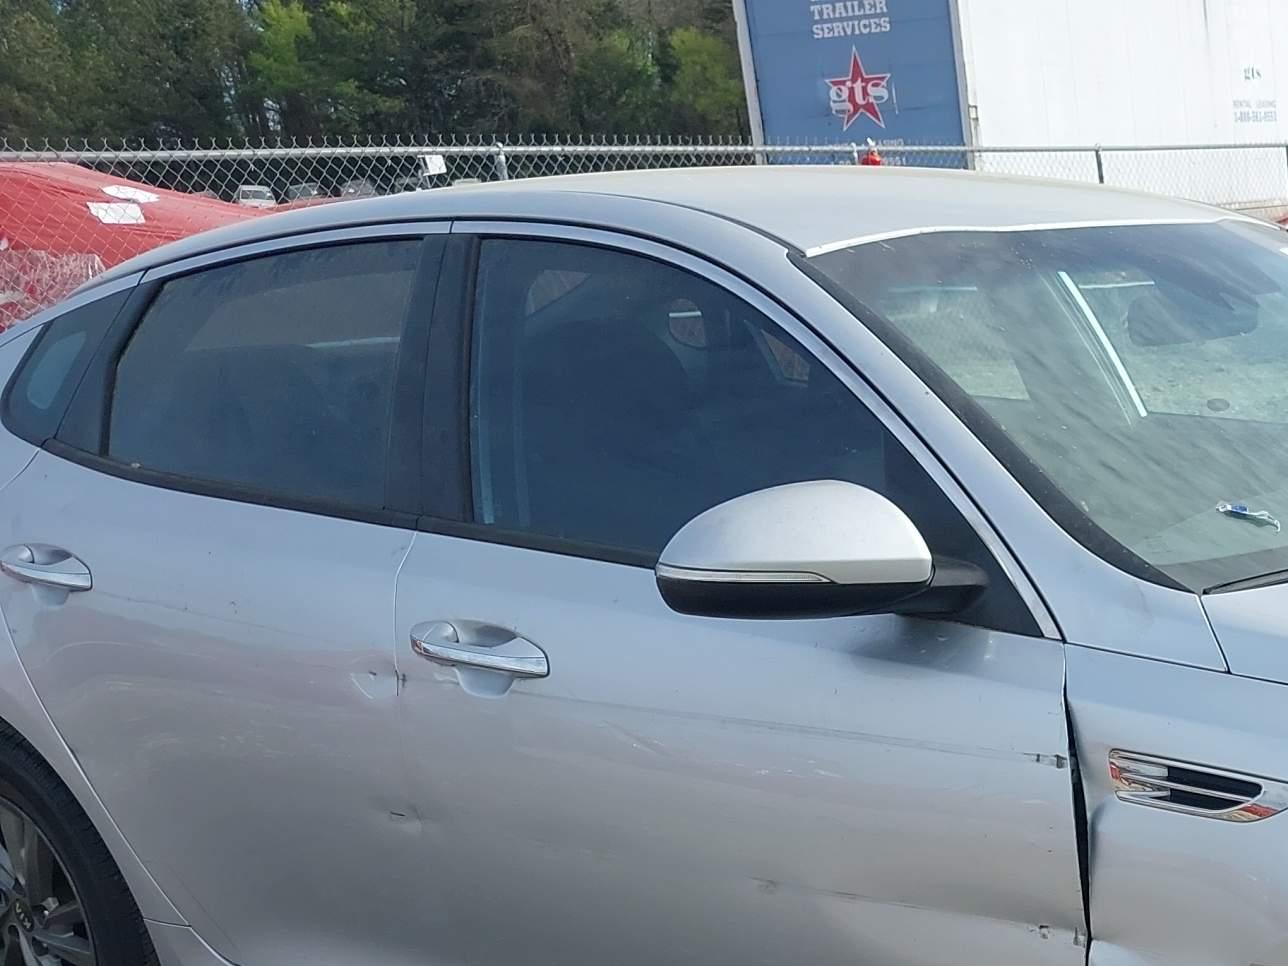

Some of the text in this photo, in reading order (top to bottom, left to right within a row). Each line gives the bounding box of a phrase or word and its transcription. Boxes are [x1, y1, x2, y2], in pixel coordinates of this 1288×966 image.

[810, 0, 888, 20] TRAILER
[812, 17, 891, 39] SERVICES
[829, 77, 889, 118] gts
